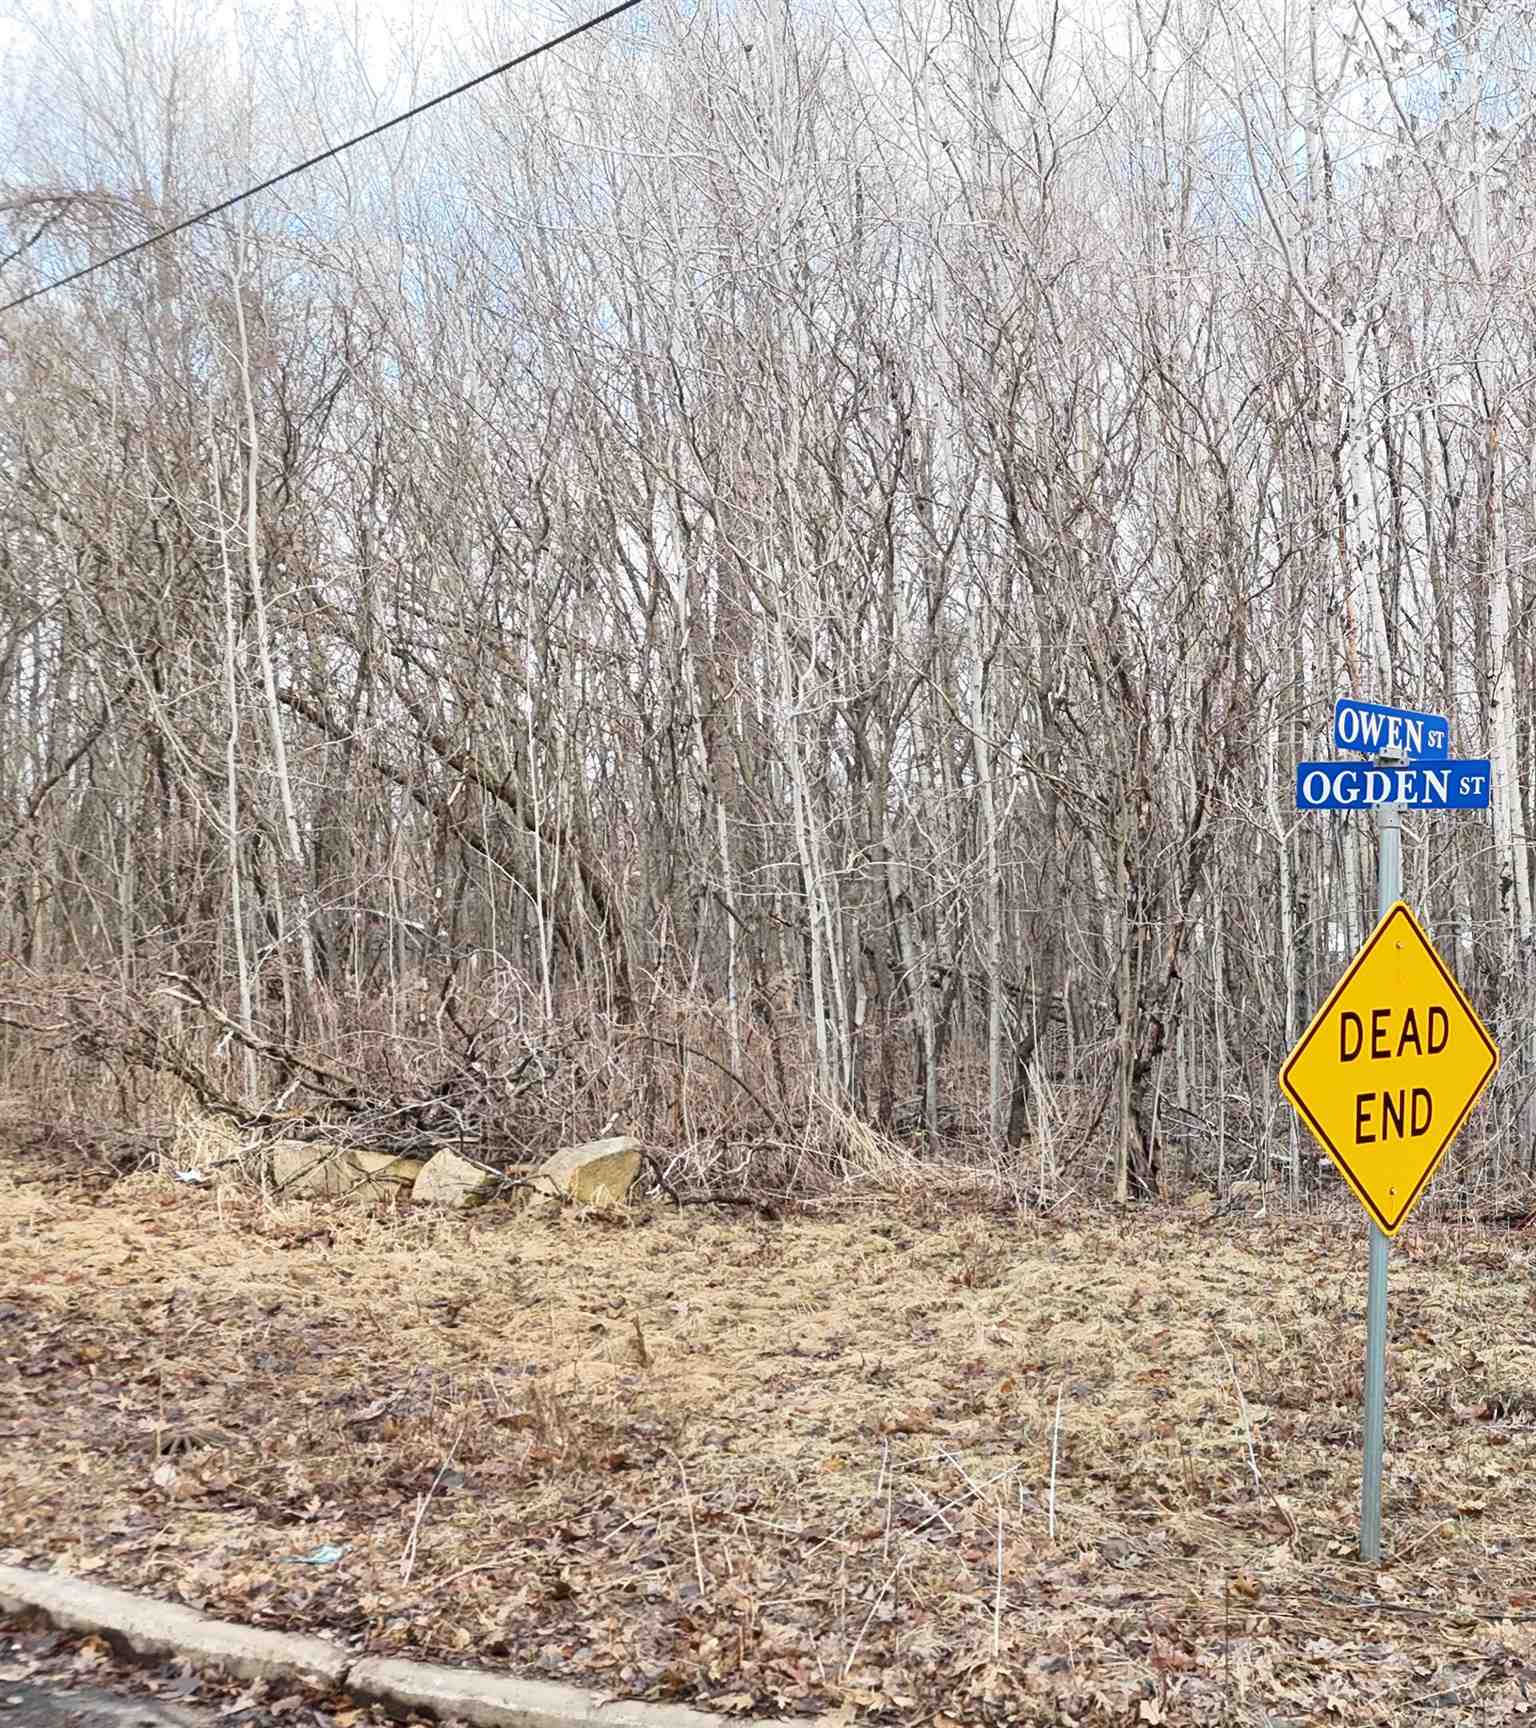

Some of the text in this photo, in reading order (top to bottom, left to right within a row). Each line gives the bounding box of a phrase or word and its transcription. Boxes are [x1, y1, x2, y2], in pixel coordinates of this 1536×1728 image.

[1338, 708, 1445, 753] OWEN ST
[1302, 770, 1486, 804] OGDEN ST
[1339, 1006, 1449, 1063] DEAD
[1355, 1087, 1432, 1145] END
